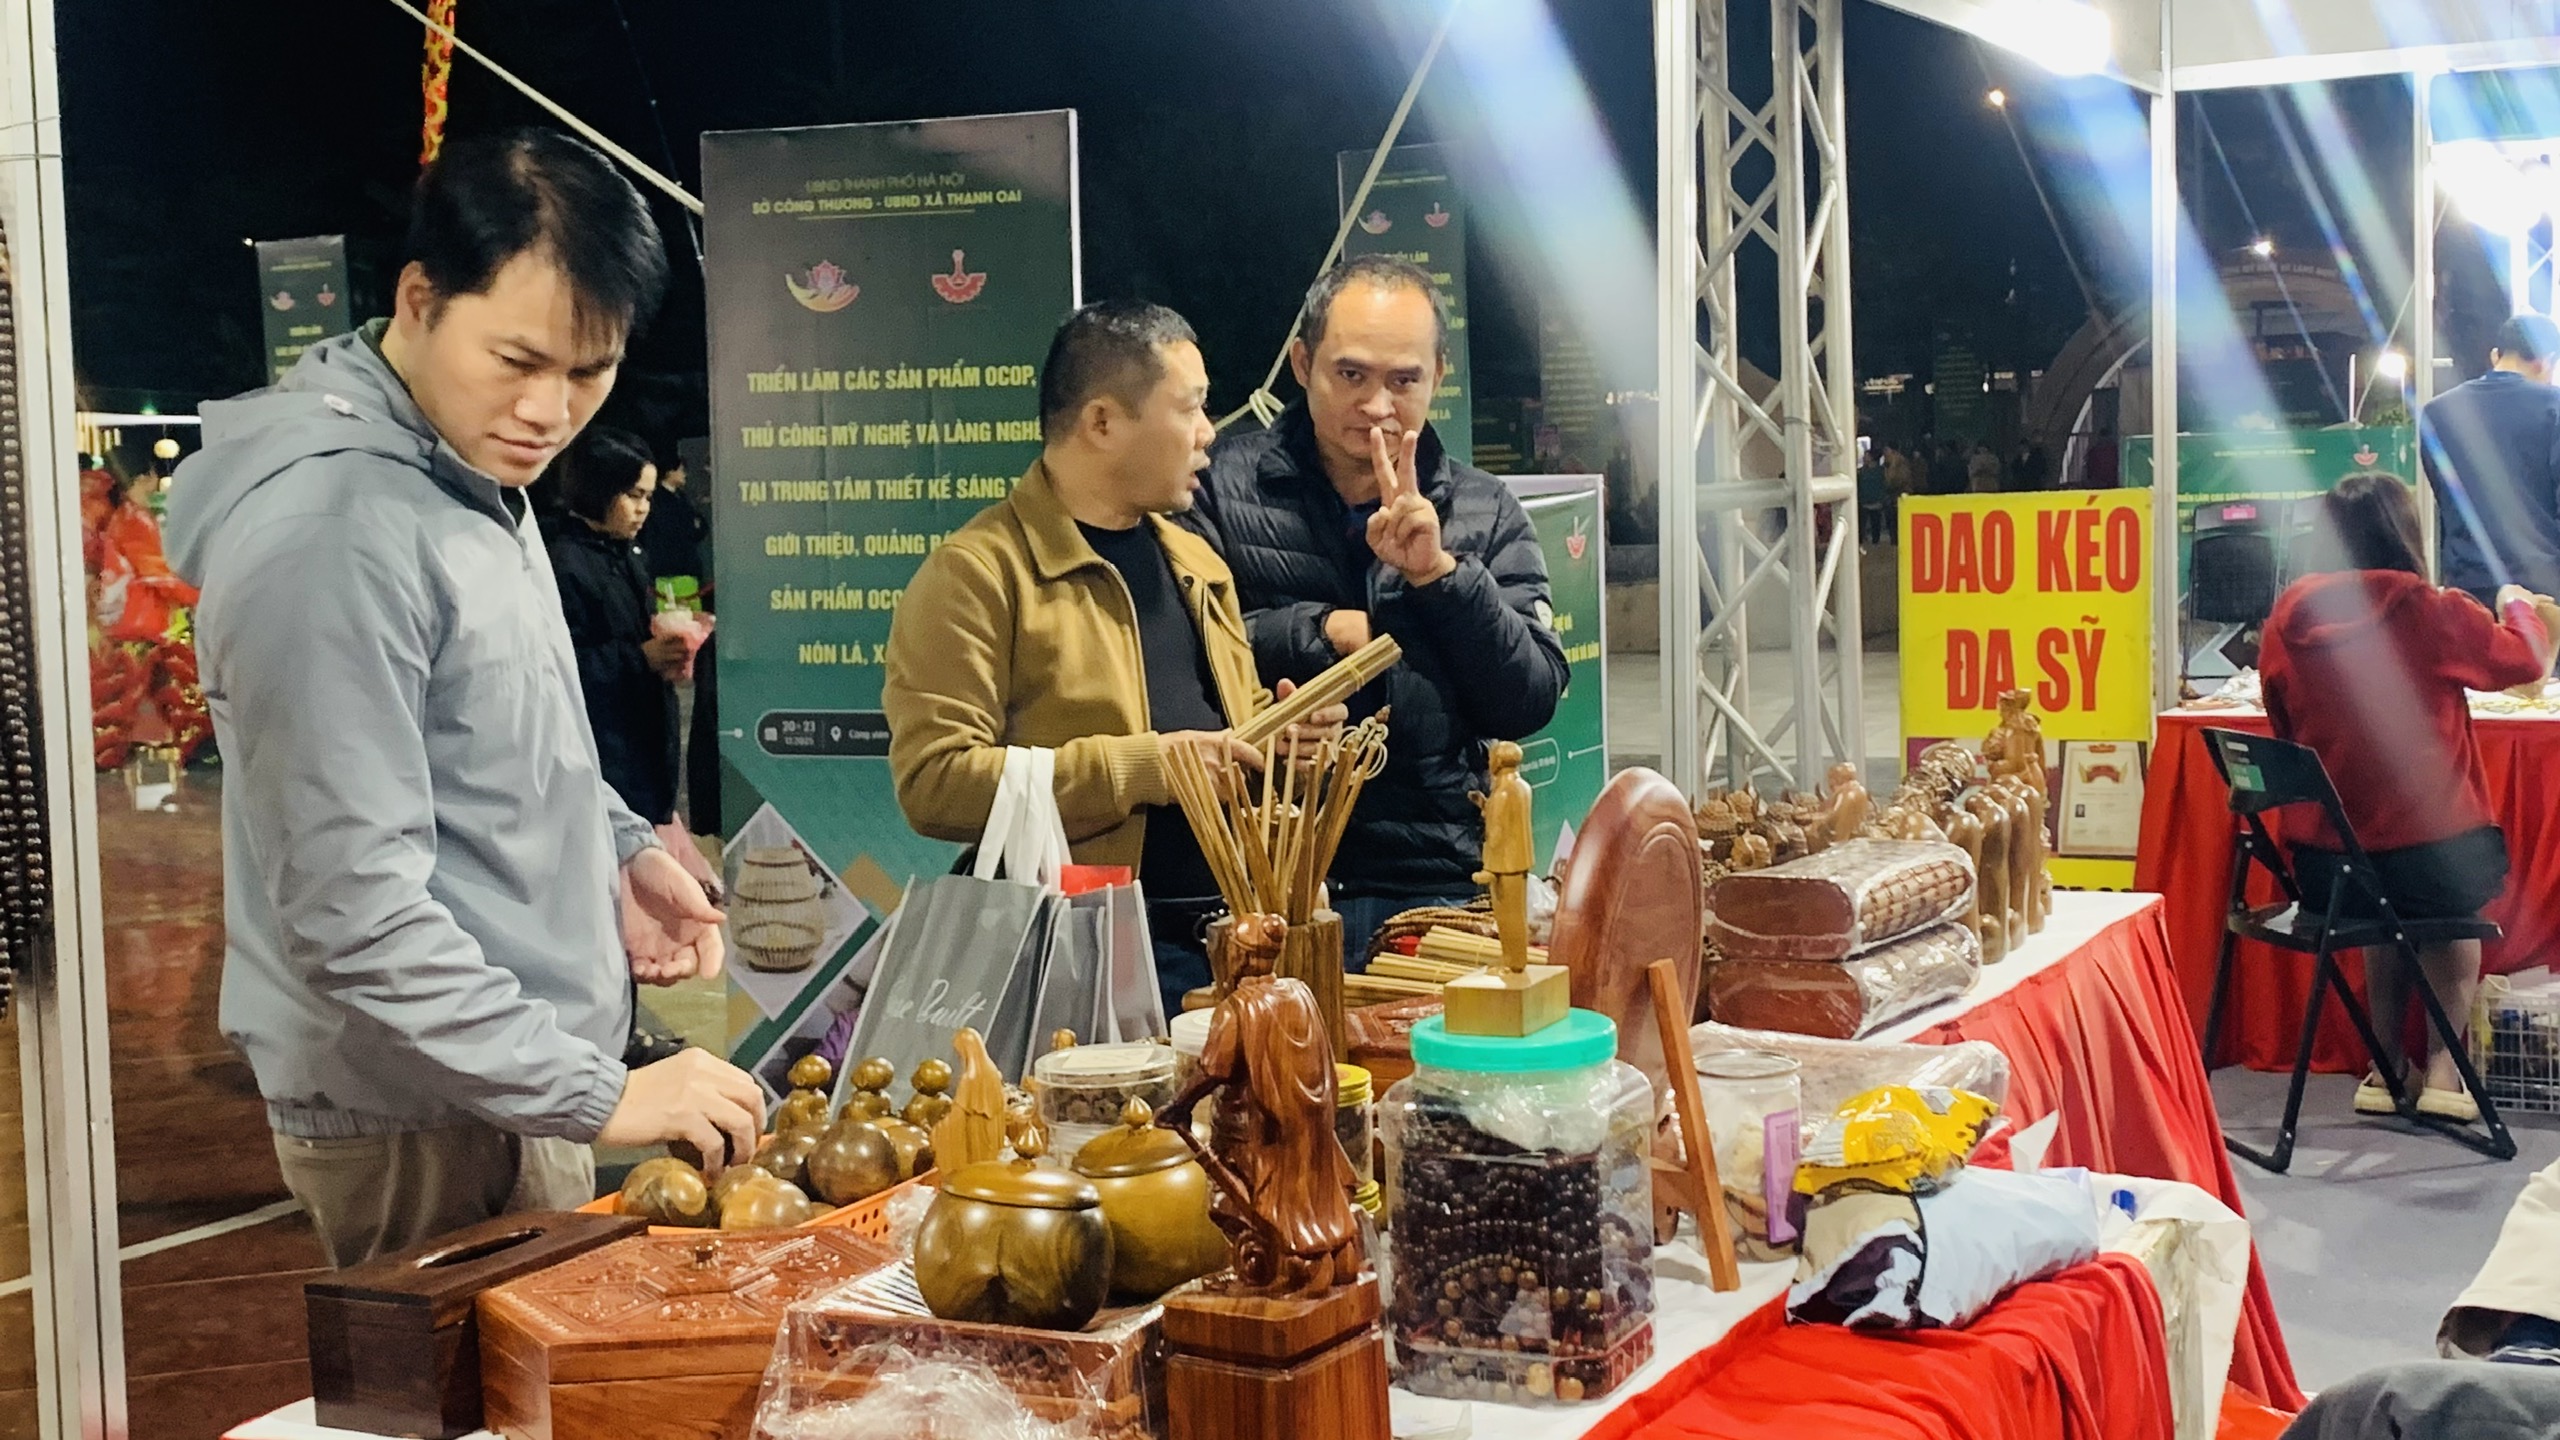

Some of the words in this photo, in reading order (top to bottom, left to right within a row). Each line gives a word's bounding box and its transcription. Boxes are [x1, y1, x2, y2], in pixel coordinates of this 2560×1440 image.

[774, 198, 815, 213] CÔNG
[884, 194, 921, 209] UBND
[947, 190, 993, 206] THANH
[747, 364, 797, 393] TRIỂN
[802, 367, 840, 392] LÃM
[845, 366, 880, 390] CÁC
[885, 362, 922, 389] SẢN
[927, 358, 980, 388] PHẨM
[985, 365, 1038, 388] OCOP,
[741, 420, 774, 448] THỦ
[779, 422, 827, 447] CÔNG
[831, 421, 860, 445] MỸ
[863, 420, 912, 449] NGHỆ
[944, 418, 991, 443] LÀNG
[739, 480, 767, 506] TẠI
[771, 479, 829, 502] TRUNG
[833, 476, 871, 500] TÂM
[876, 472, 923, 500] THIẾT
[928, 472, 953, 499] KẾ
[956, 473, 1006, 499] SÁNG
[765, 531, 800, 556] GIỚI
[805, 531, 859, 559] THIỆU,
[864, 528, 925, 556] QUẢNG
[1911, 510, 2015, 594] DAO
[2036, 495, 2140, 593] KÉO
[770, 583, 807, 610] SẢN
[811, 581, 863, 610] PHẨM
[799, 640, 837, 664] NÓN
[873, 644, 889, 664] X
[1945, 629, 2016, 711] ĐA
[2036, 615, 2106, 712] SỸ
